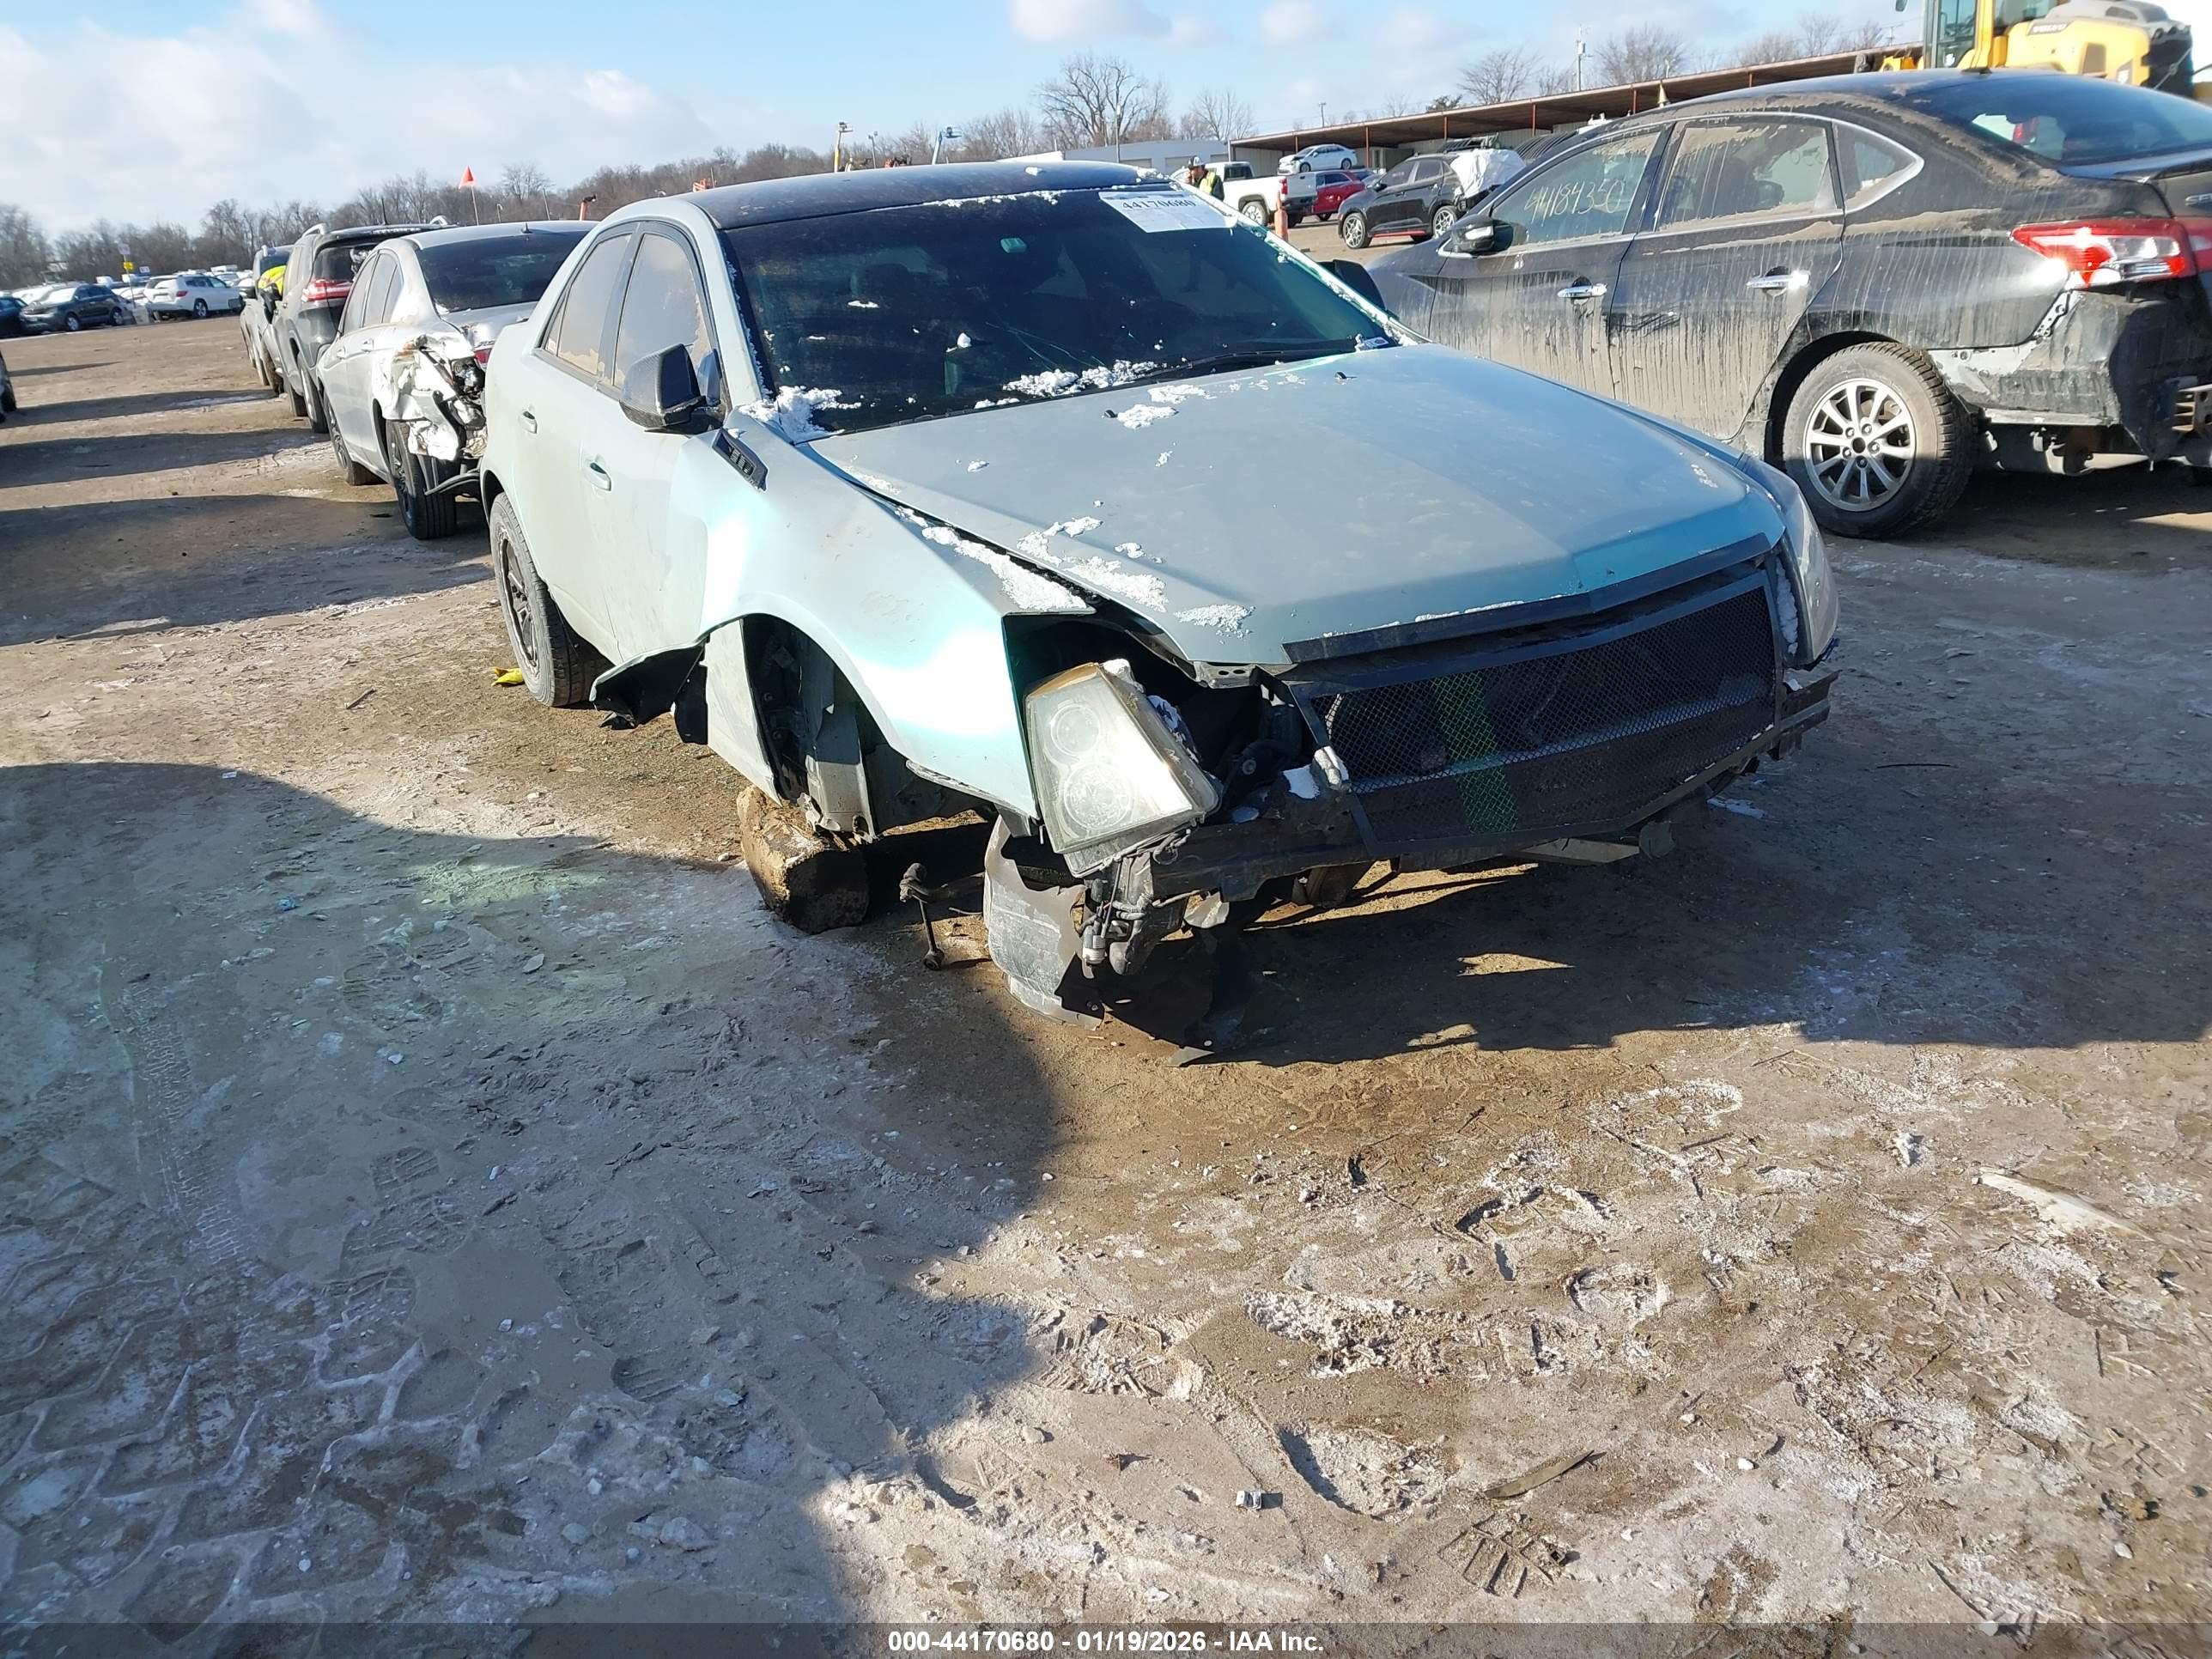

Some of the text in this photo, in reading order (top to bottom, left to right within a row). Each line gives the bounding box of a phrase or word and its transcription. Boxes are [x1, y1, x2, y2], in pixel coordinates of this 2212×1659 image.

[1122, 199, 1196, 209] 44170680
[1524, 178, 1626, 227] 44184350
[2185, 192, 2212, 206] SE
